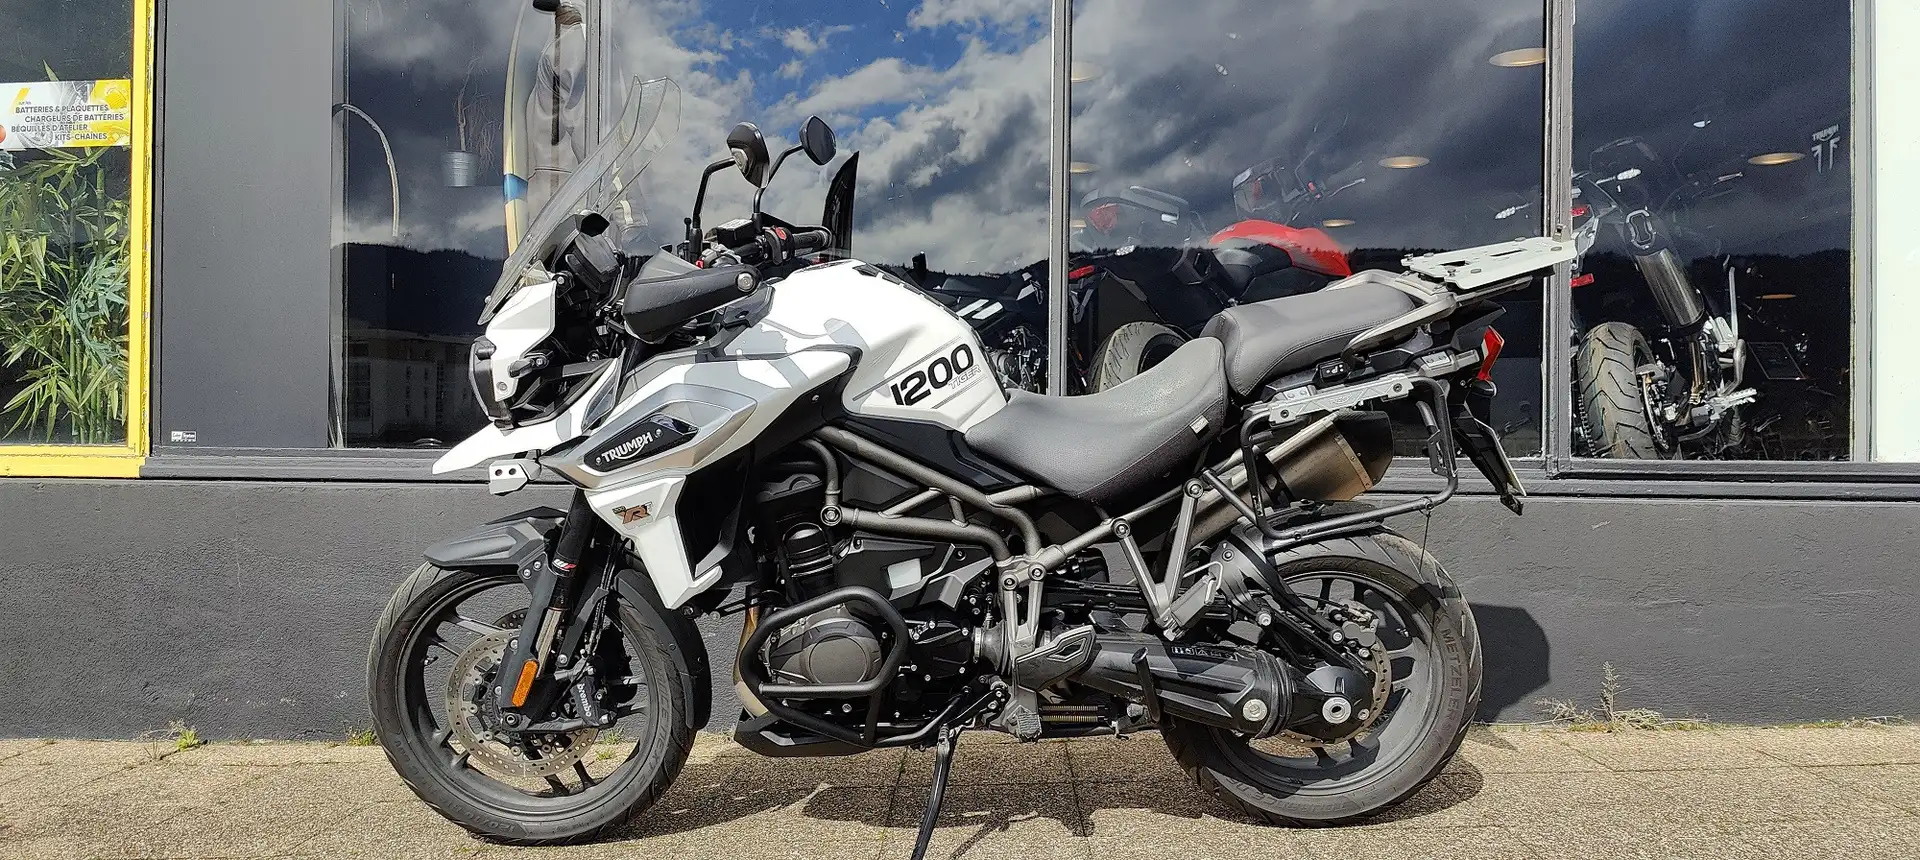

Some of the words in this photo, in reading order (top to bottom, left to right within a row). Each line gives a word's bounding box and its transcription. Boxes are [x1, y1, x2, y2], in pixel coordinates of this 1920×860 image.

[24, 114, 71, 123] CHARGEURS
[84, 113, 124, 121] BATTERIES
[61, 104, 109, 112] PLAQUETTES
[11, 124, 50, 132] BÉQUILLES
[890, 343, 974, 406] 1200
[948, 364, 981, 389] TIGER
[601, 432, 653, 462] TRIUMPH
[1441, 628, 1462, 720] METZELER
[577, 683, 592, 718] brembo
